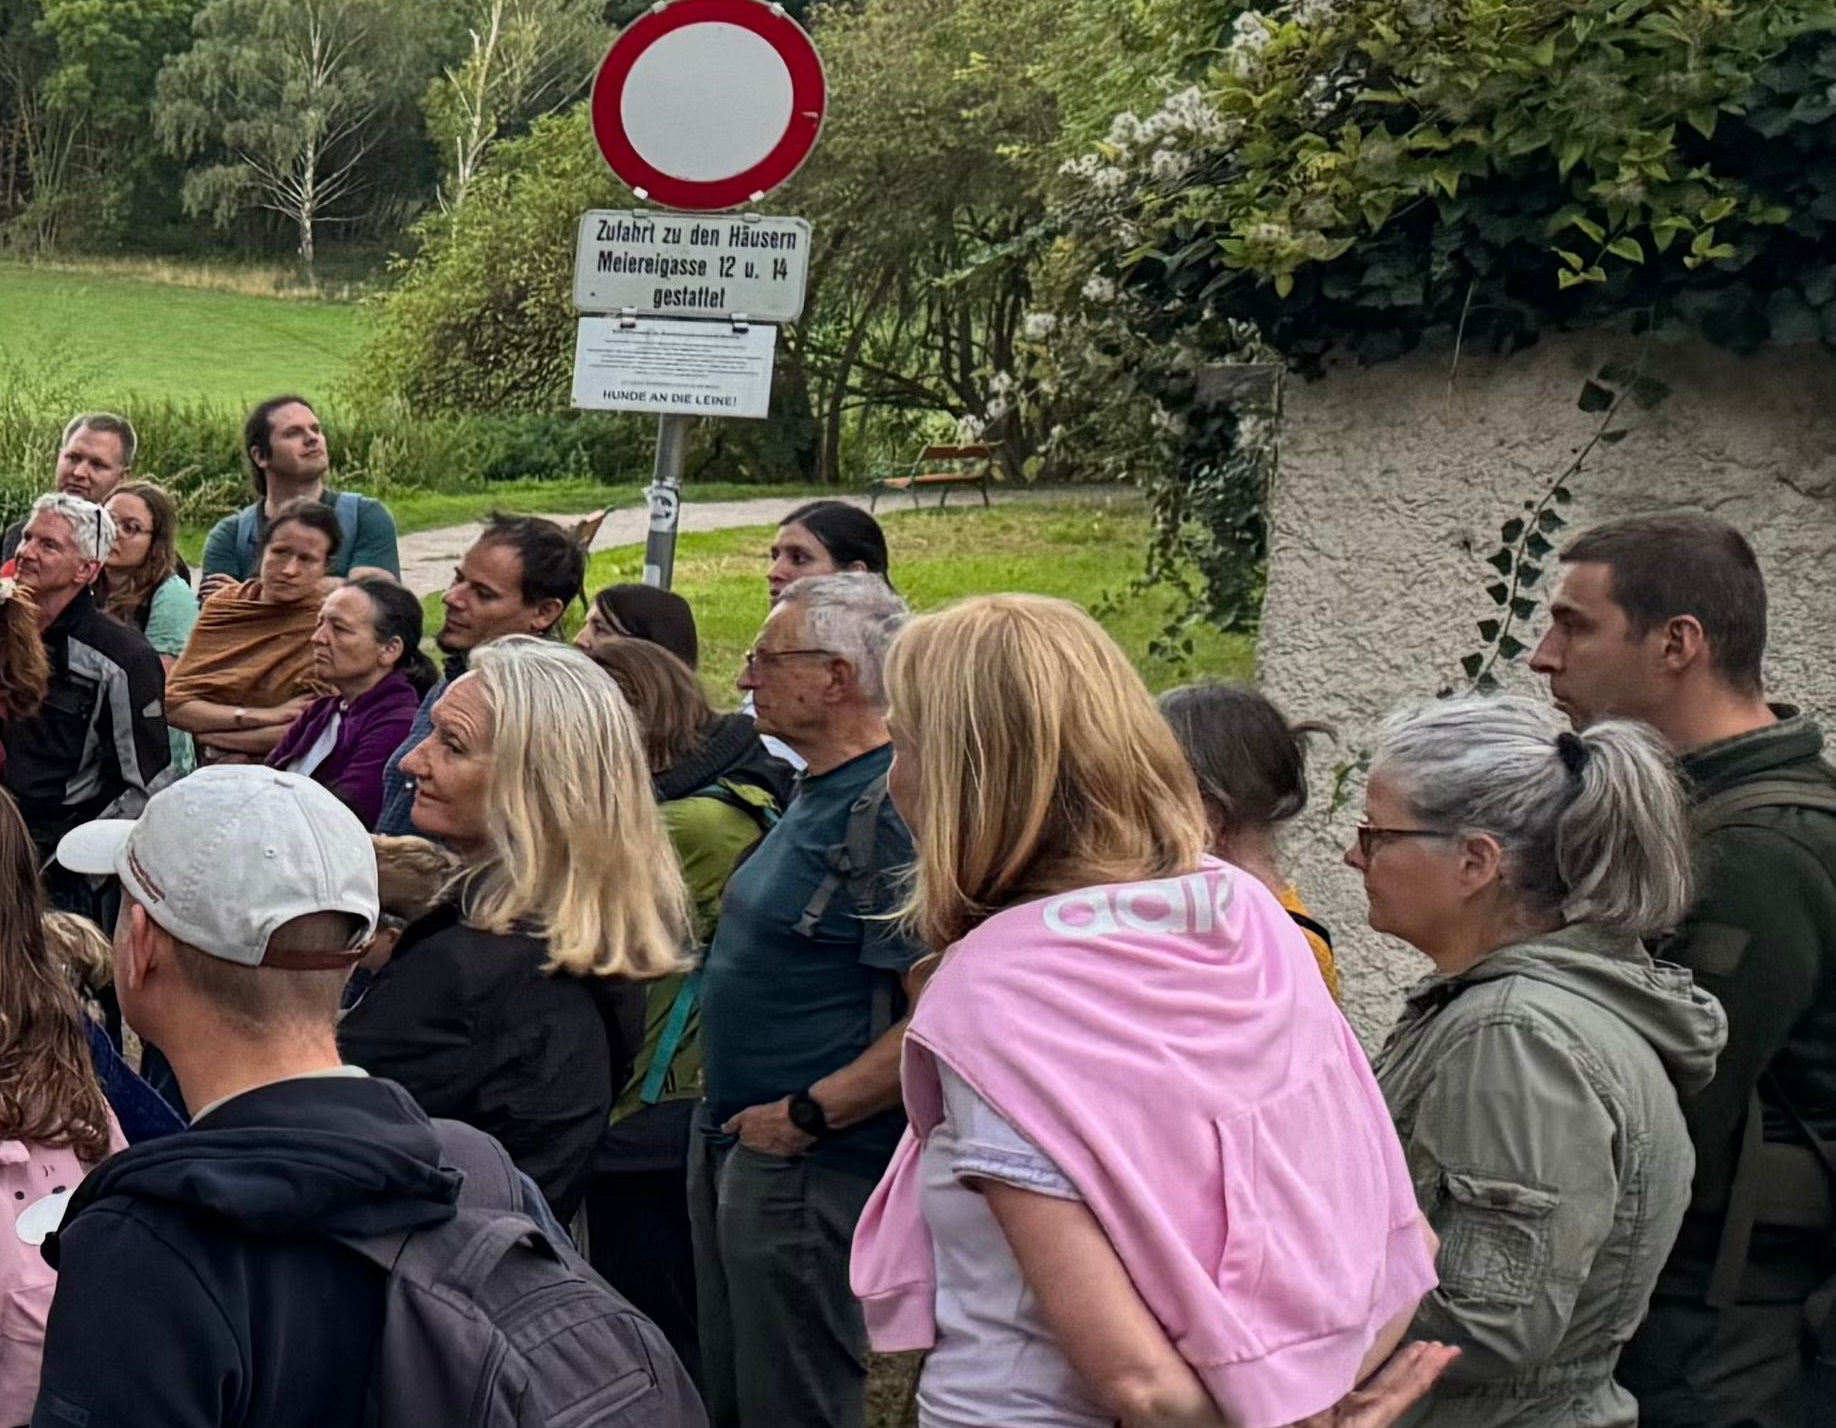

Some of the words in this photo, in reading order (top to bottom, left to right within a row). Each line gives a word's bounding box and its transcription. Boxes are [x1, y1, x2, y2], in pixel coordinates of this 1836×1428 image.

[596, 219, 655, 245] Zufahrt
[662, 225, 682, 244] zu
[690, 223, 720, 247] den
[729, 225, 797, 250] Häusern
[597, 250, 707, 278] Meiereigasse
[719, 255, 736, 278] 12
[744, 260, 759, 280] u.
[772, 257, 788, 281] 14
[652, 286, 726, 309] gestattet
[603, 389, 647, 403] HUNDE
[649, 391, 668, 403] AN
[671, 392, 692, 405] DIE
[695, 393, 737, 407] LEINE!
